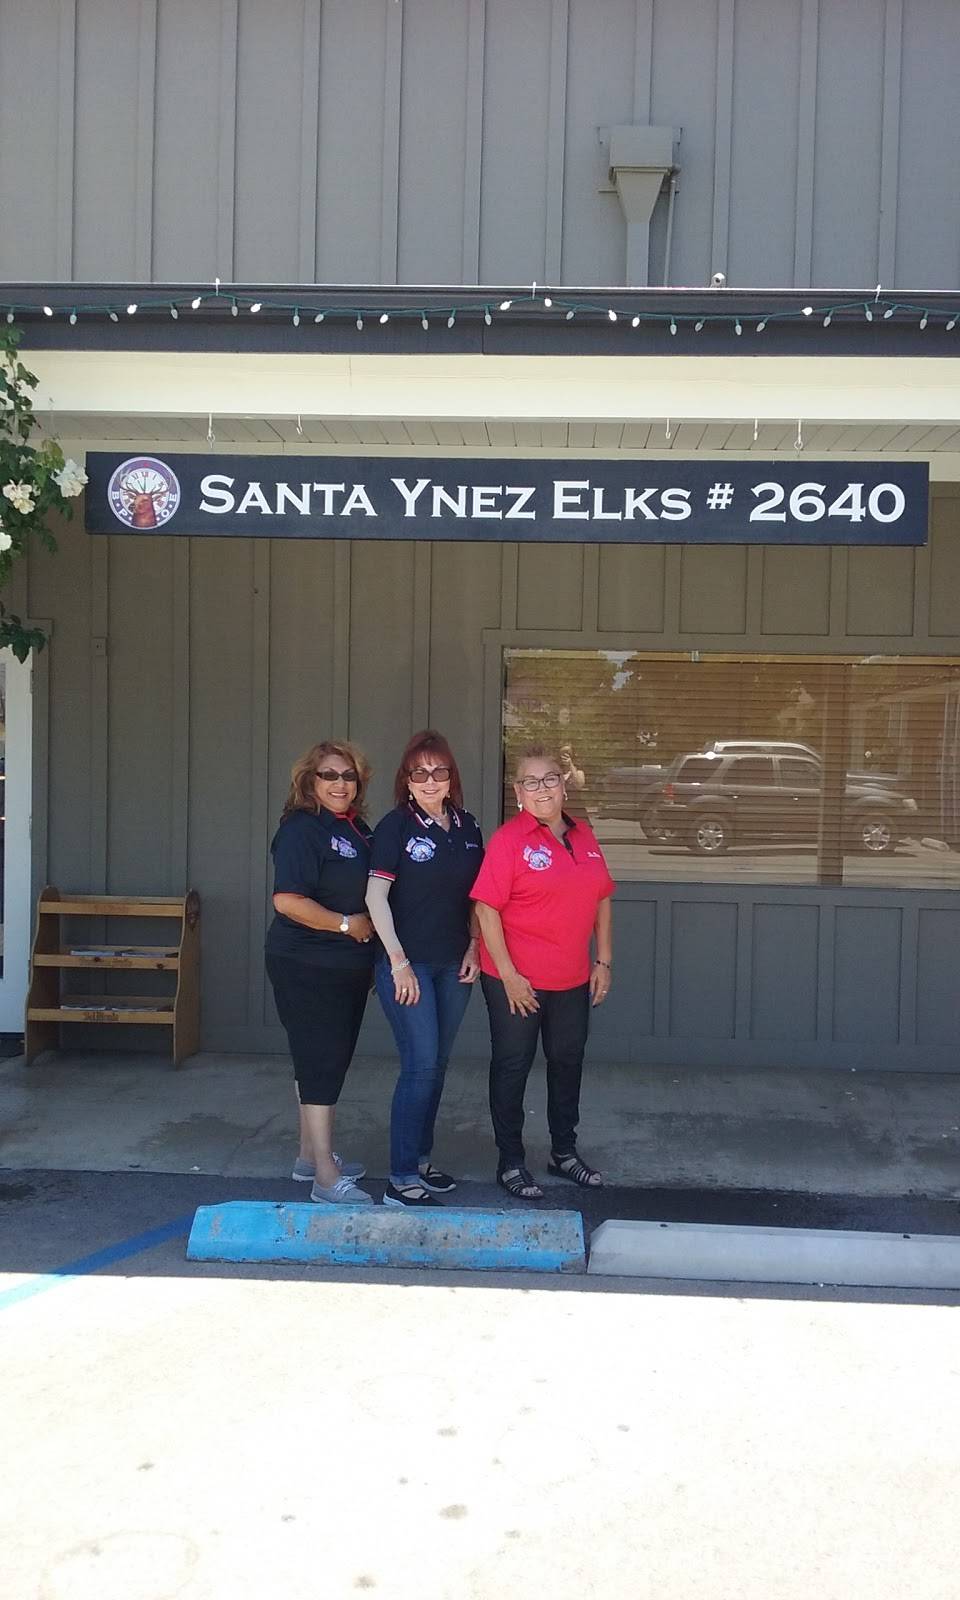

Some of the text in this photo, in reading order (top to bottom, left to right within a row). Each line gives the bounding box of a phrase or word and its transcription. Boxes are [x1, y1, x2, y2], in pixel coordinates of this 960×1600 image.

[198, 474, 906, 523] SANTA YNEZ ELKS # 2640
